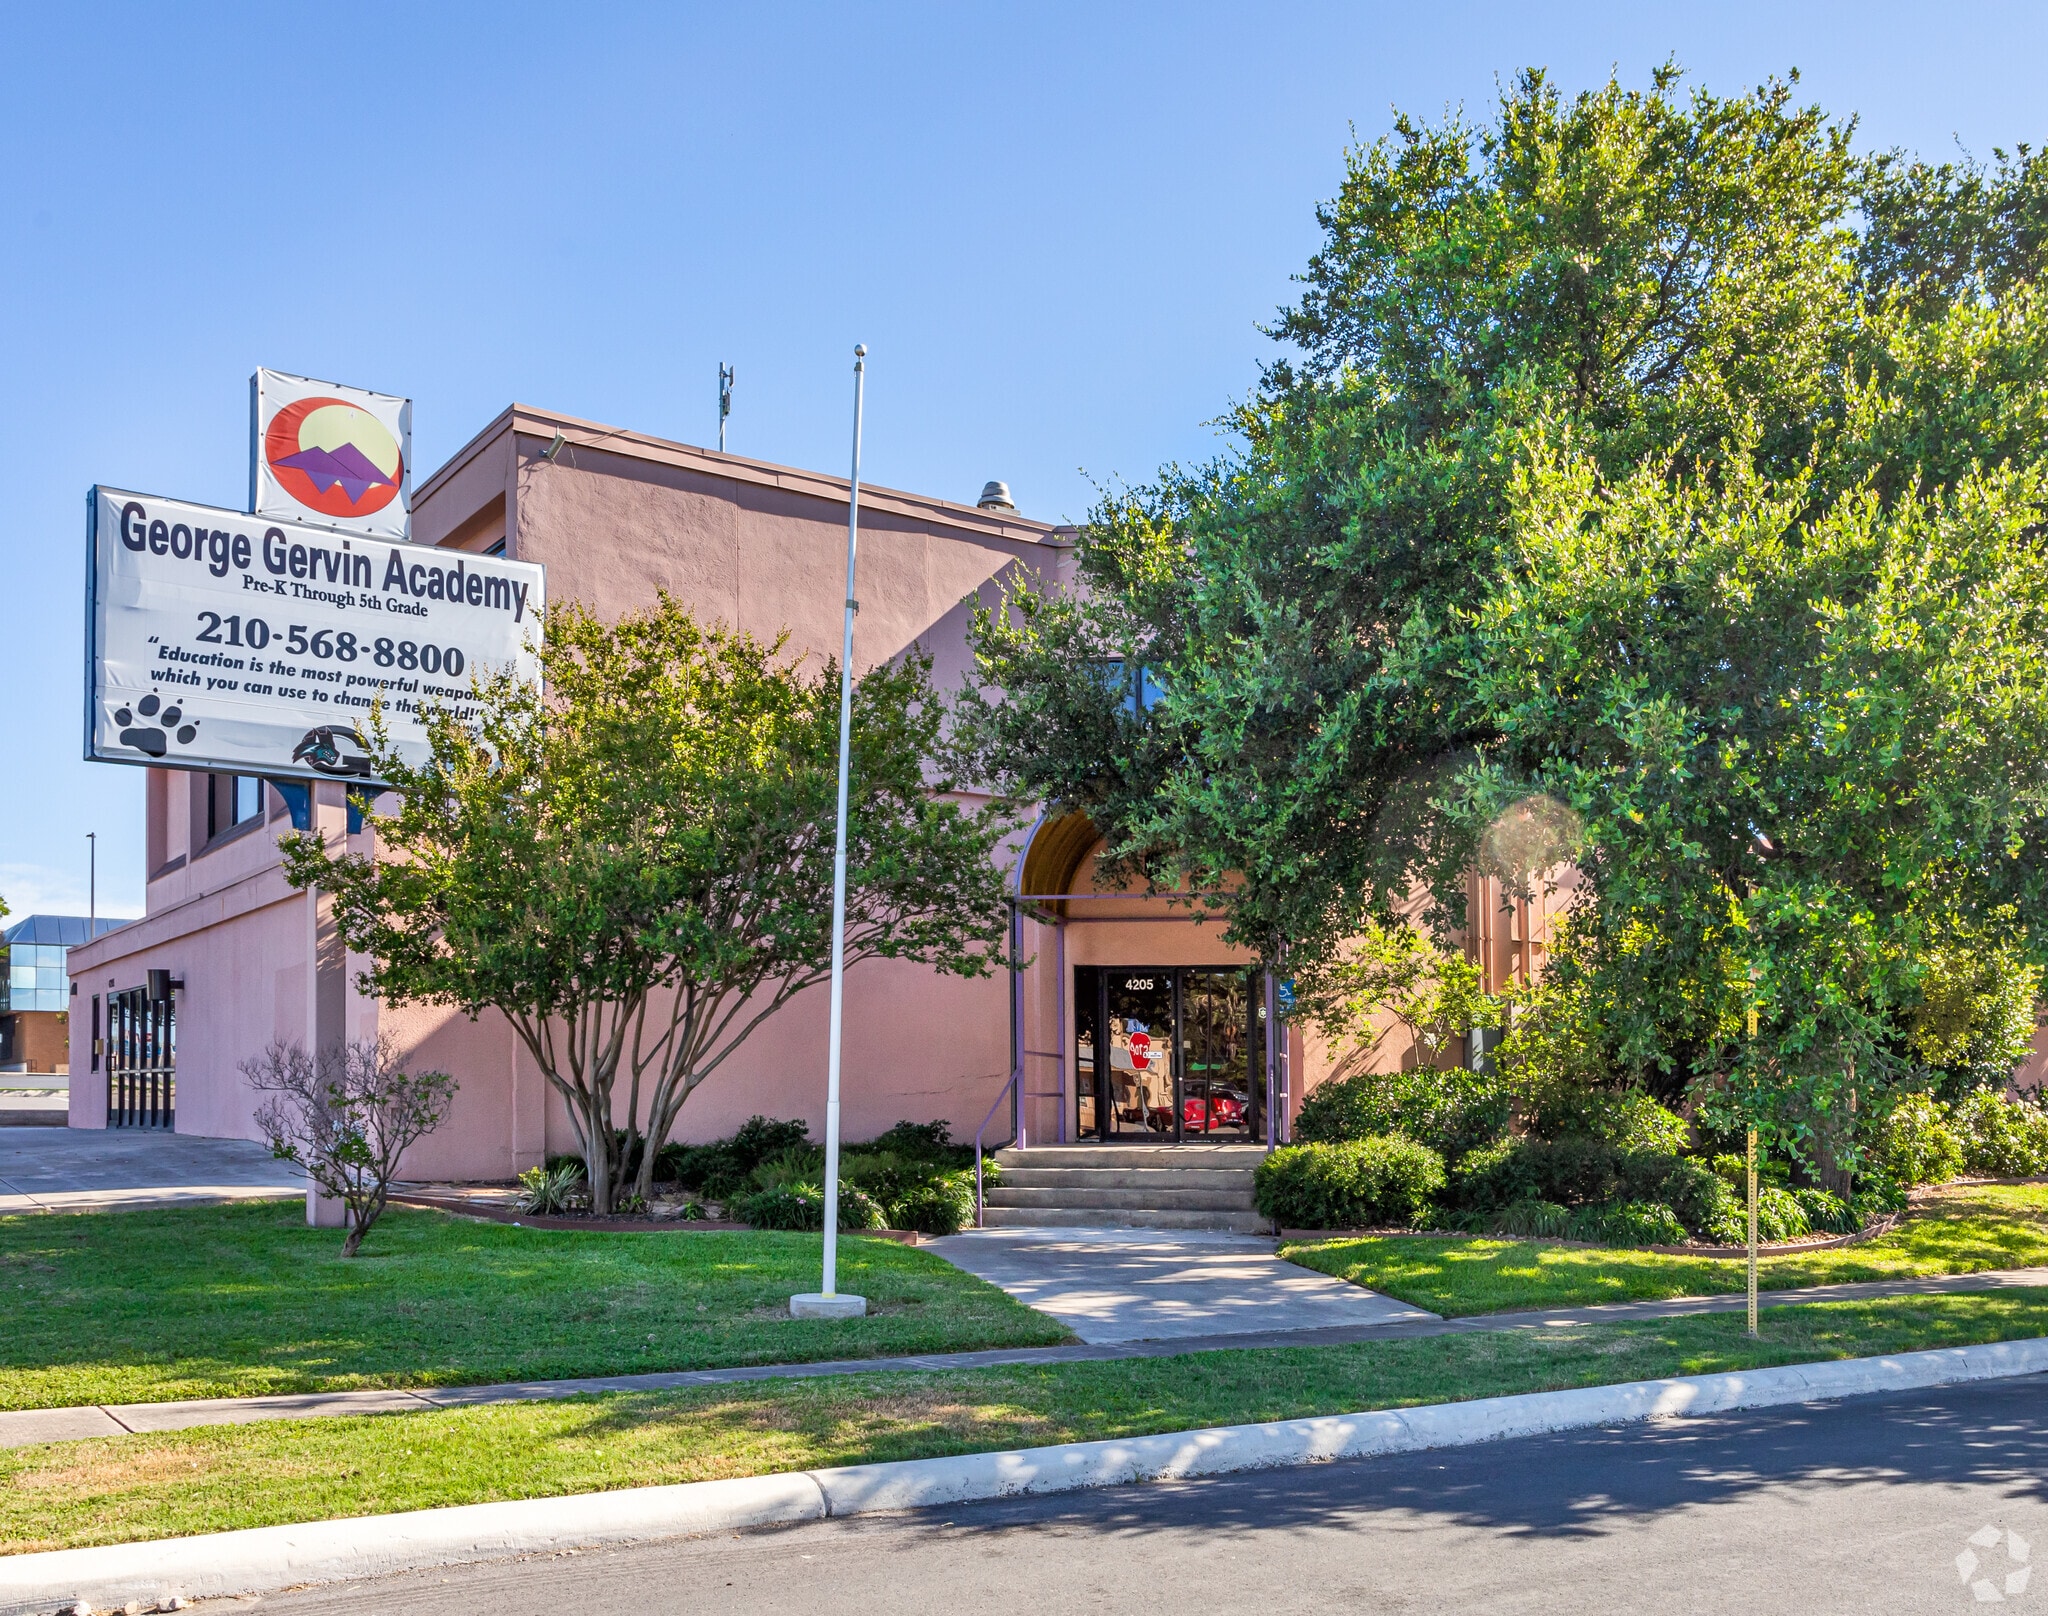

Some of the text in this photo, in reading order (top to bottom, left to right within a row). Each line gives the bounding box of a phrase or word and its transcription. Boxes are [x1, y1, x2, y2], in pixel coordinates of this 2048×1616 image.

[120, 501, 529, 624] George Gervin Academy
[242, 574, 429, 618] Pre-K Through 5th Grade
[150, 667, 201, 686] which
[206, 676, 239, 690] you
[243, 682, 273, 695] can
[277, 686, 307, 700] use
[312, 688, 329, 703] to
[333, 690, 391, 711] chane
[395, 698, 421, 714] the
[249, 656, 264, 673] is
[268, 660, 297, 677] the
[301, 668, 343, 683] most
[345, 674, 419, 693] powerful
[1125, 979, 1154, 991] 4205
